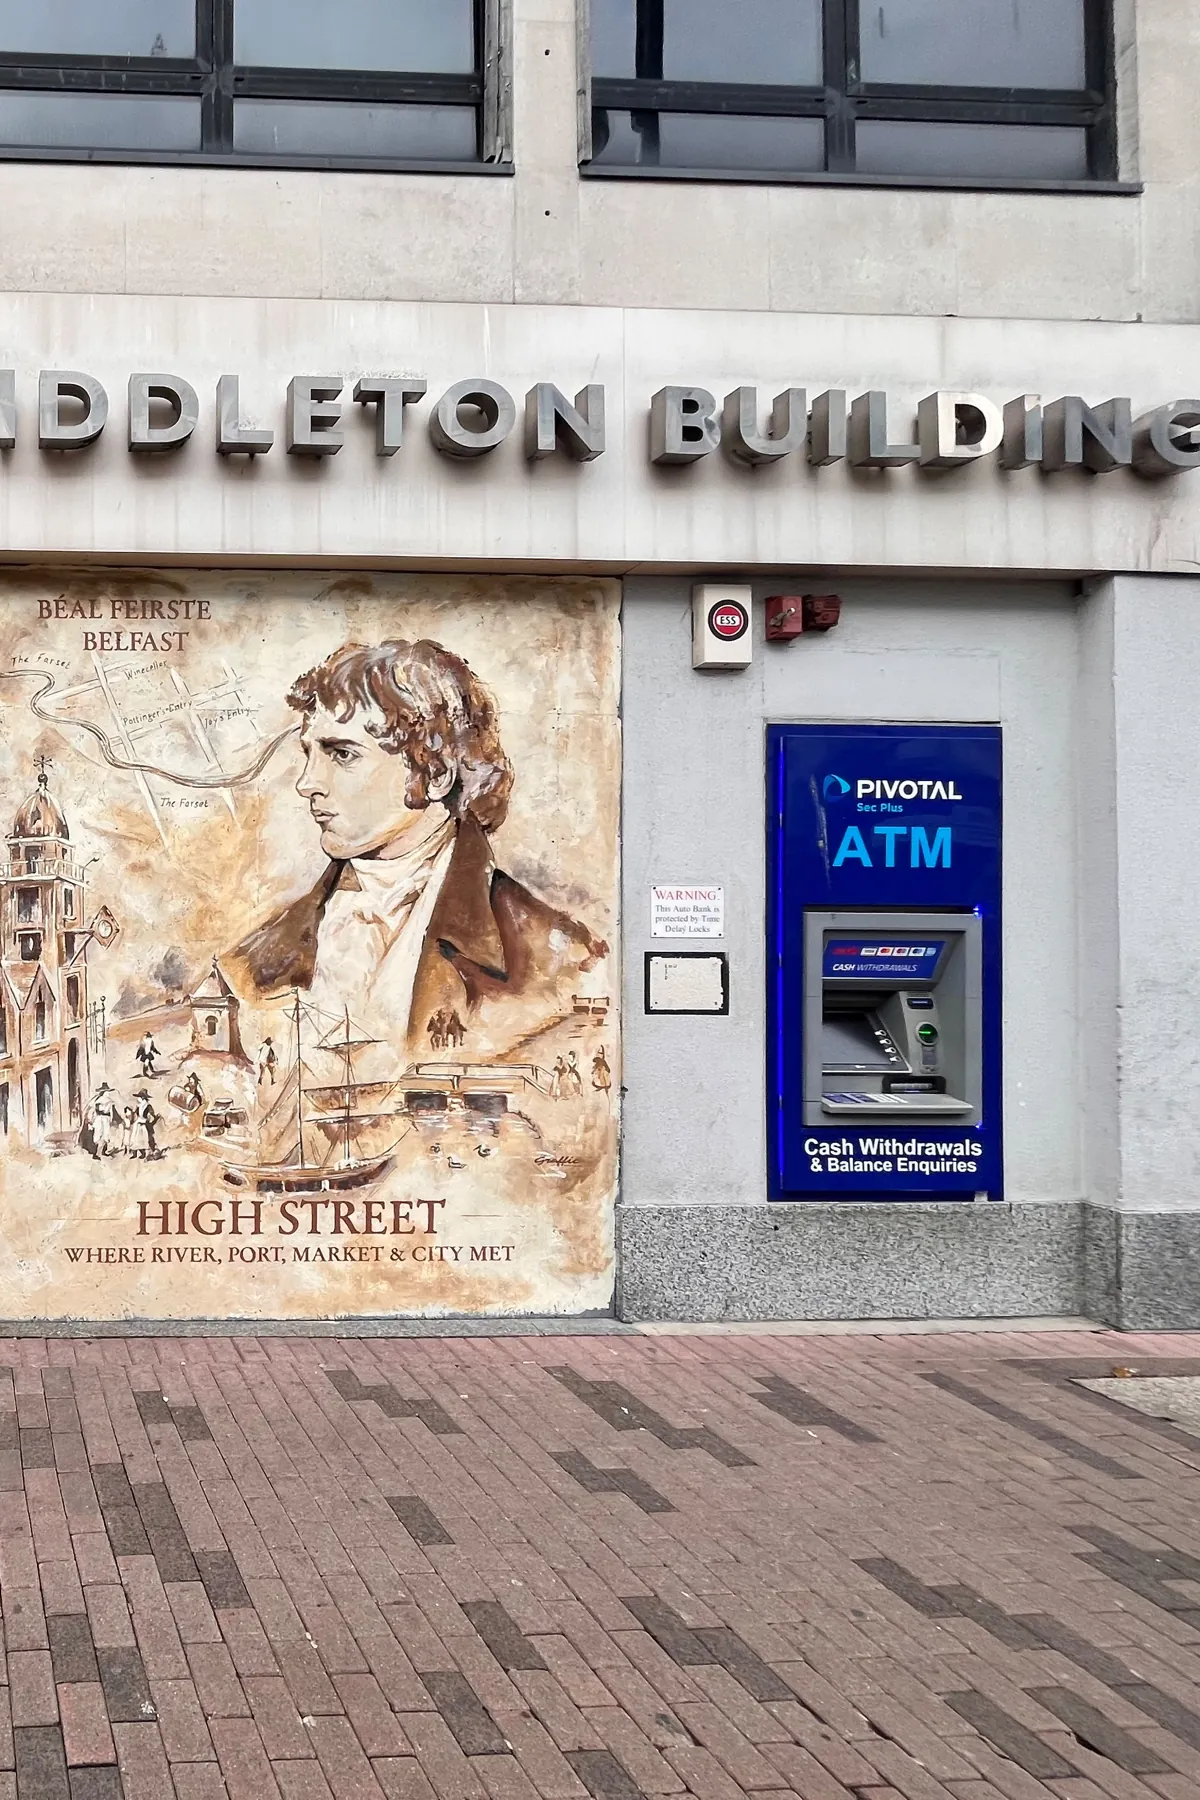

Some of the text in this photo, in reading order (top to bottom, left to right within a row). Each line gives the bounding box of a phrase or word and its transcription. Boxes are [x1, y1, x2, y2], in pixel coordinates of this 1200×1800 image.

[651, 383, 1200, 476] BUILDING
[37, 594, 212, 620] BÉAL FEIRSTE
[720, 615, 737, 626] ESS
[83, 631, 190, 652] BELFAST
[11, 653, 72, 670] The Farset
[857, 780, 963, 800] PIVOTAL
[161, 797, 209, 808] The Farset
[856, 803, 903, 813] Sec Plus
[832, 826, 951, 868] ATM
[655, 915, 688, 923] protected
[665, 926, 686, 934] Delay
[833, 963, 855, 971] CASH
[804, 1138, 982, 1156] Cash Withdrawals
[810, 1158, 977, 1175] & Balance Enquiries
[136, 1198, 446, 1236] HIGH STREET
[64, 1246, 515, 1265] WHERE RIVER, PORT, MARKET & CITY MET
